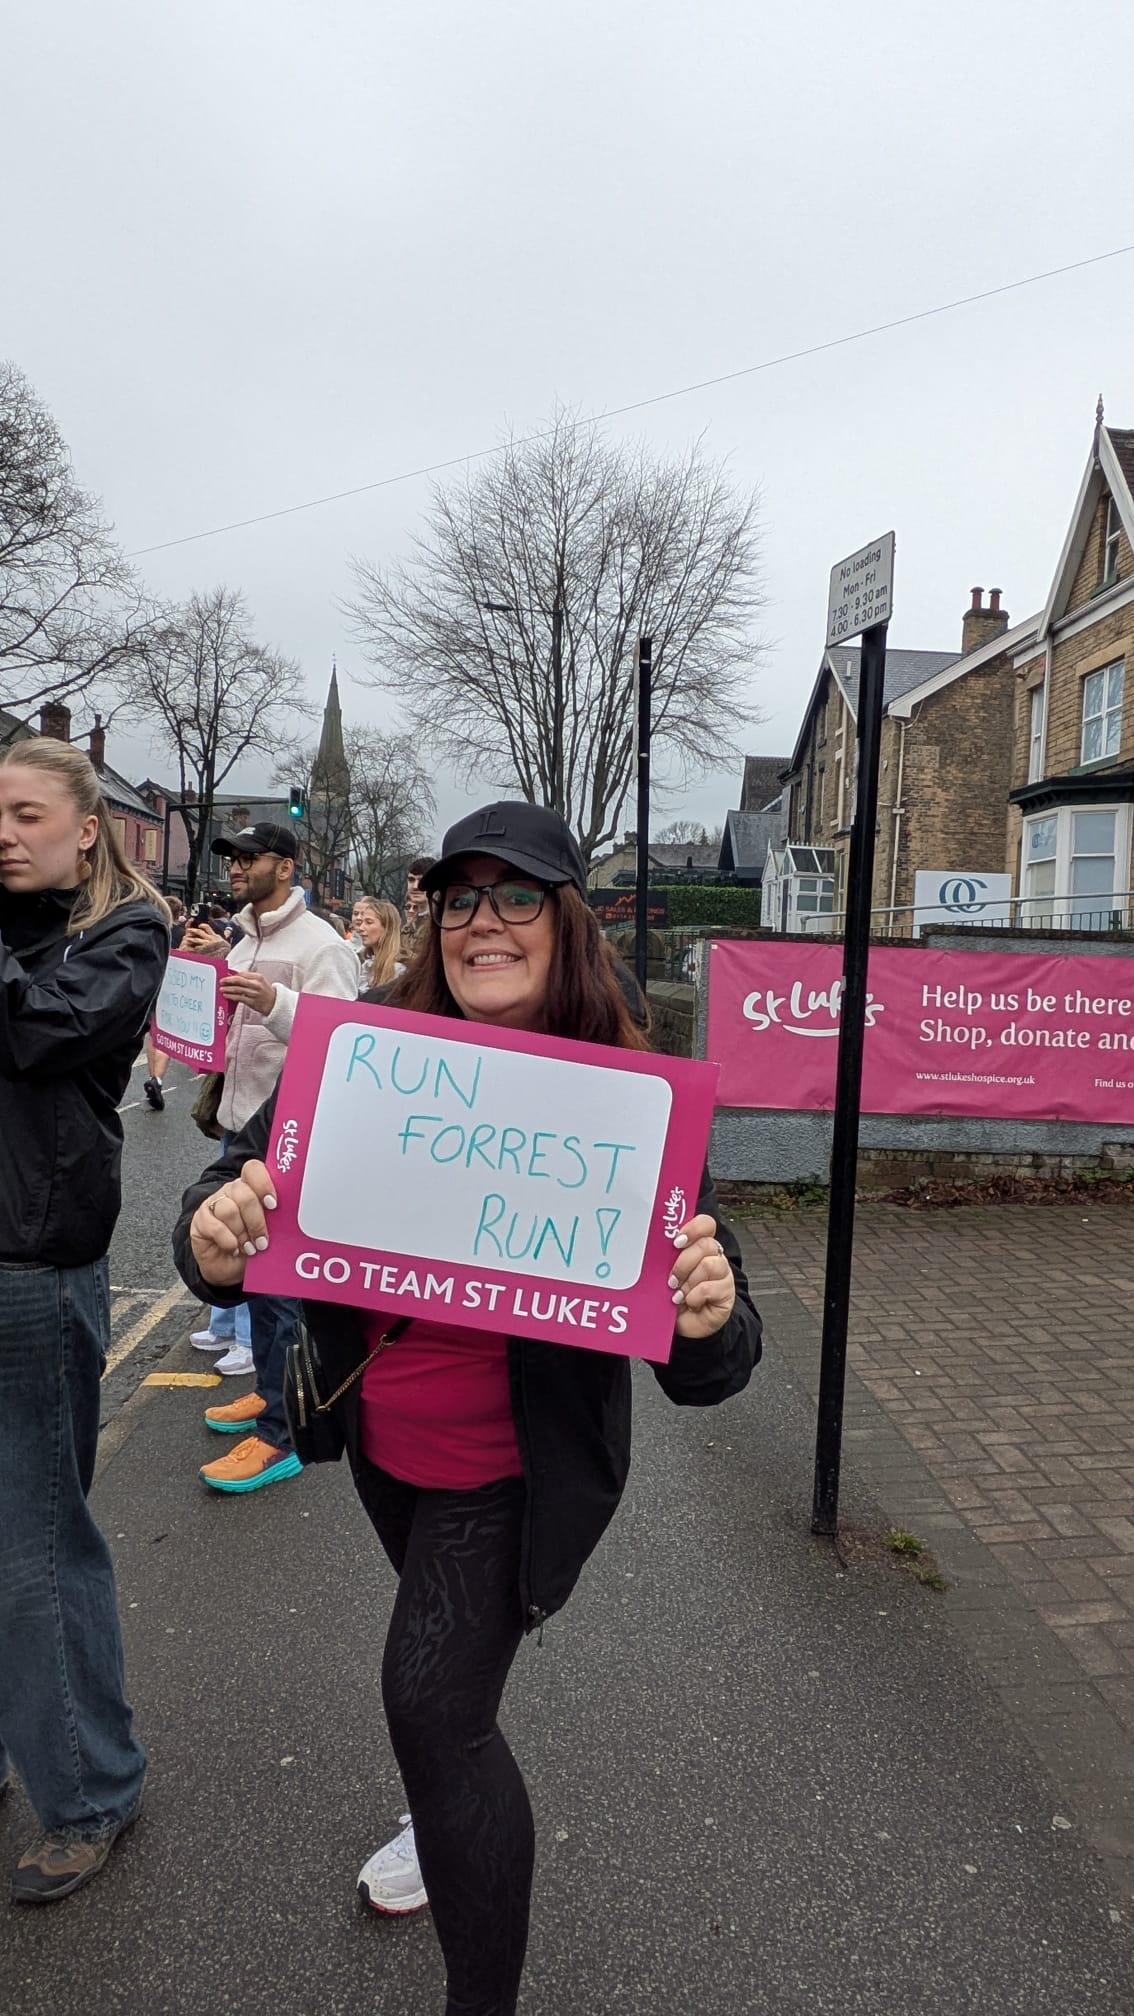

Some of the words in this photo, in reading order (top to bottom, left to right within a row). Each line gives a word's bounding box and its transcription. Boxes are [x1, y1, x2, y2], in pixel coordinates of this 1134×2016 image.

[840, 568, 850, 580] No
[853, 549, 881, 573] loading
[843, 581, 859, 598] Mon
[865, 569, 876, 586] Fri
[855, 588, 874, 610] 9.30
[875, 584, 888, 599] am
[831, 620, 848, 637] 4.00
[854, 606, 873, 626] 6.30
[874, 602, 887, 618] pm
[922, 984, 982, 1015] Help
[990, 994, 1019, 1011] us
[1027, 988, 1057, 1012] be
[1064, 990, 1132, 1016] there
[156, 1034, 164, 1044] GO
[164, 1037, 177, 1052] TEAM
[177, 1043, 184, 1054] ST
[185, 1046, 213, 1062] LUKE'S
[919, 1019, 993, 1050] Shop,
[1001, 1022, 1090, 1048] donate
[346, 1033, 482, 1109] RUN
[916, 1072, 1035, 1086] www.stlukeshospice.org.uk
[1094, 1078, 1114, 1088] Find
[398, 1116, 636, 1193] FORREST
[295, 1252, 350, 1284] GO
[359, 1261, 455, 1304] TEAM
[462, 1281, 506, 1311] ST
[512, 1288, 629, 1334] LUKE'S
